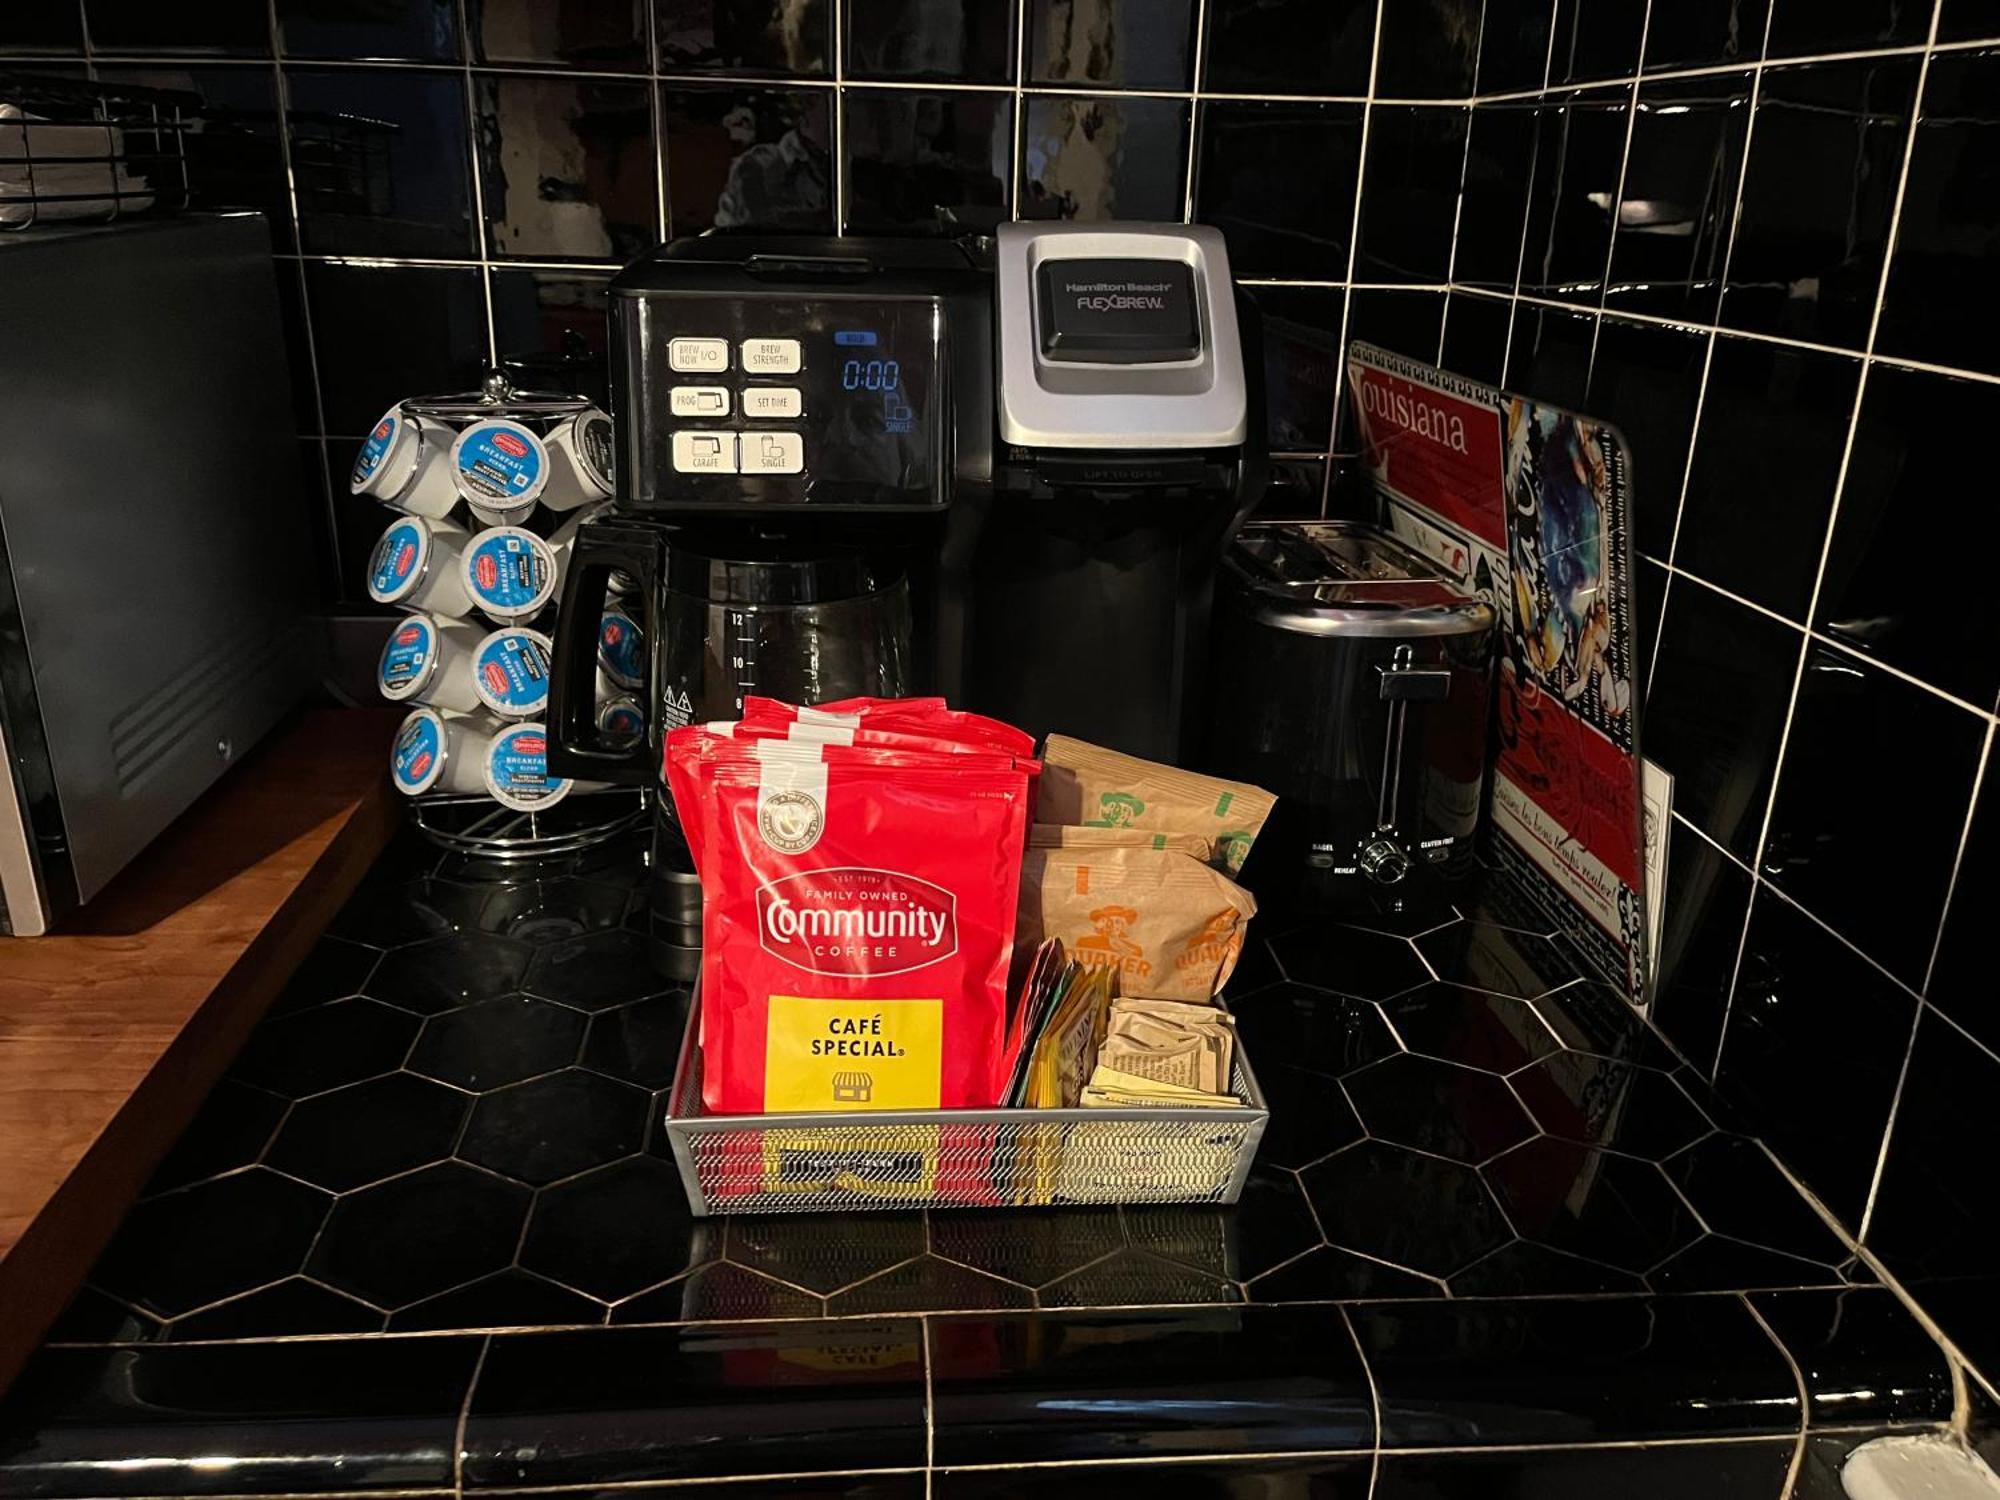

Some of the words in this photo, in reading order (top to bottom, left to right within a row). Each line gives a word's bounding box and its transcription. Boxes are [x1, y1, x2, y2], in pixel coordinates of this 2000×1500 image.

[1065, 282, 1126, 292] Hamilton
[679, 344, 699, 355] BREW
[760, 344, 781, 354] BREW
[679, 354, 697, 365] NOW
[753, 354, 789, 365] STRENGTH
[843, 360, 899, 390] 0:00
[757, 397, 771, 408] SET
[772, 397, 788, 408] TIME
[761, 458, 786, 468] SINGLE
[1613, 450, 1625, 486] pods
[1615, 489, 1627, 551] exposing
[1616, 553, 1626, 582] half
[732, 613, 743, 626] 12
[733, 657, 744, 669] 10
[736, 698, 742, 710] 8
[505, 756, 546, 766] BREAKFA
[806, 890, 853, 901] FAMILY
[859, 891, 908, 901] OWNED
[766, 899, 947, 945] Community
[815, 945, 897, 957] COFFEE
[828, 1014, 882, 1035] CAFÉ
